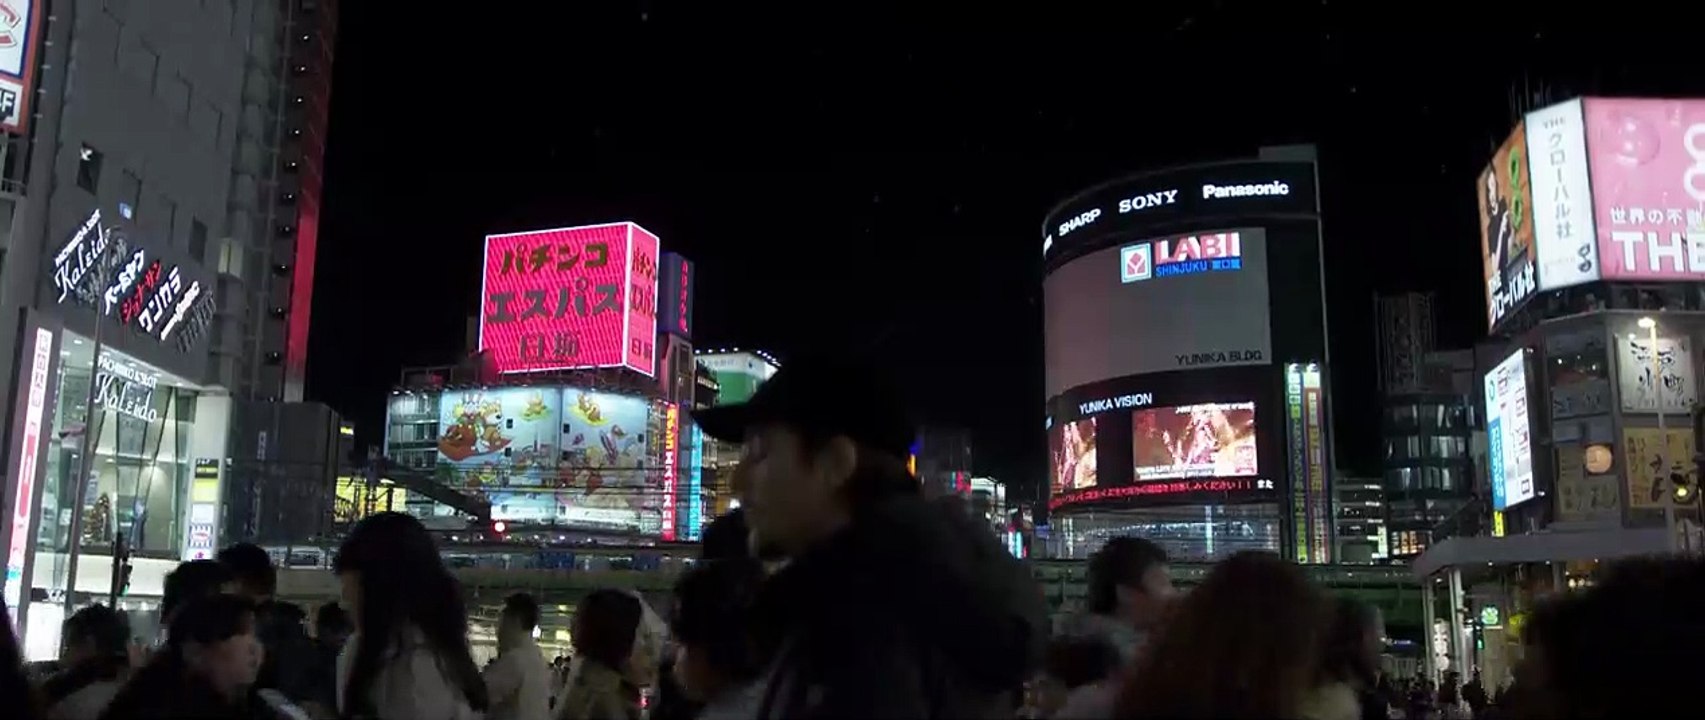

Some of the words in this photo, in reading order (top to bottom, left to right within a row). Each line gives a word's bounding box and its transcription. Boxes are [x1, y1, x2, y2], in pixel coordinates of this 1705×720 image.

[1119, 189, 1178, 213] SONY
[1202, 181, 1289, 199] Panasonic
[1059, 208, 1101, 237] SHARP
[501, 241, 609, 275] パチンコ
[1154, 232, 1241, 264] LABI
[1155, 260, 1208, 278] SHINJUKU
[138, 266, 182, 332] ワンカラ
[486, 276, 620, 323] エスパス
[1175, 351, 1227, 366] YUNIKA
[94, 372, 157, 423] Kaleido
[1079, 398, 1113, 414] YUNIKA
[1114, 392, 1152, 408] VISION
